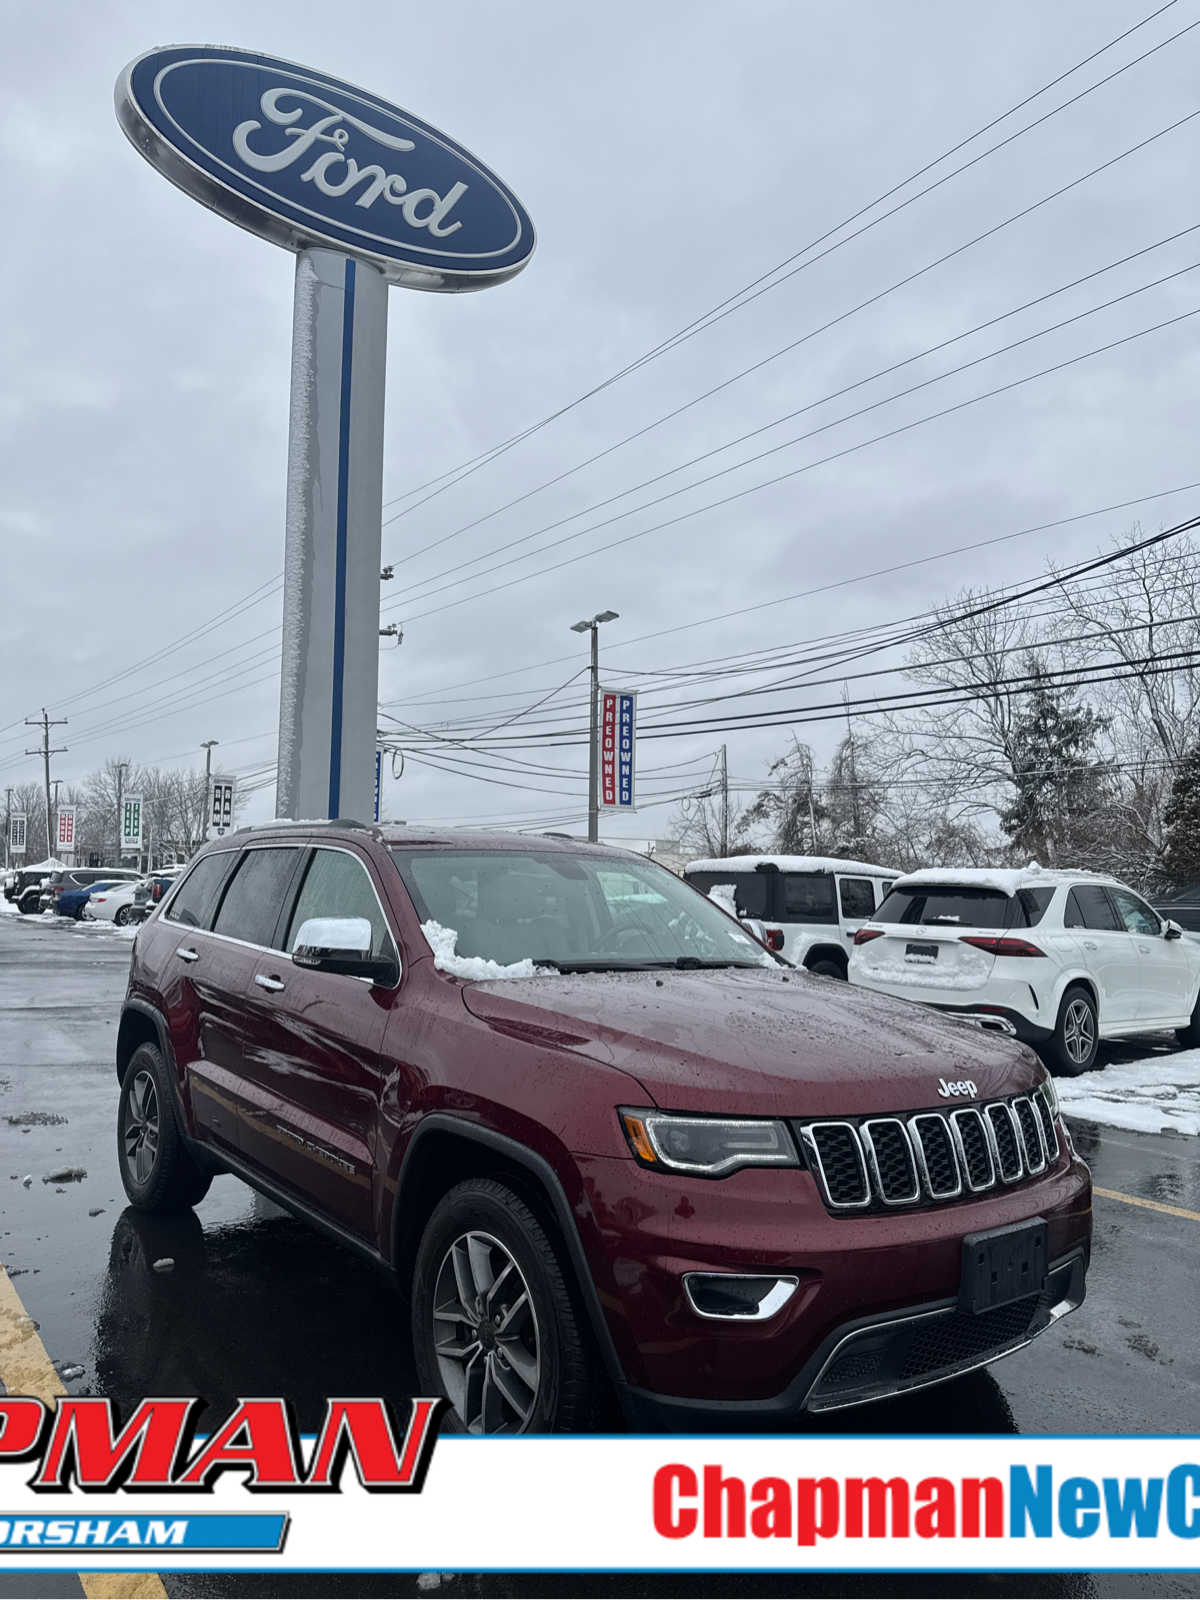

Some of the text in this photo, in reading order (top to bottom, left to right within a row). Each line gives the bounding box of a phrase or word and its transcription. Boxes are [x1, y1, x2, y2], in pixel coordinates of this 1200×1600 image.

[233, 88, 469, 238] Ford
[604, 699, 614, 801] PREOWNED
[621, 700, 632, 802] PREOWNED
[213, 788, 221, 825] RAM
[223, 789, 231, 826] RAM
[937, 1078, 978, 1098] Jeep
